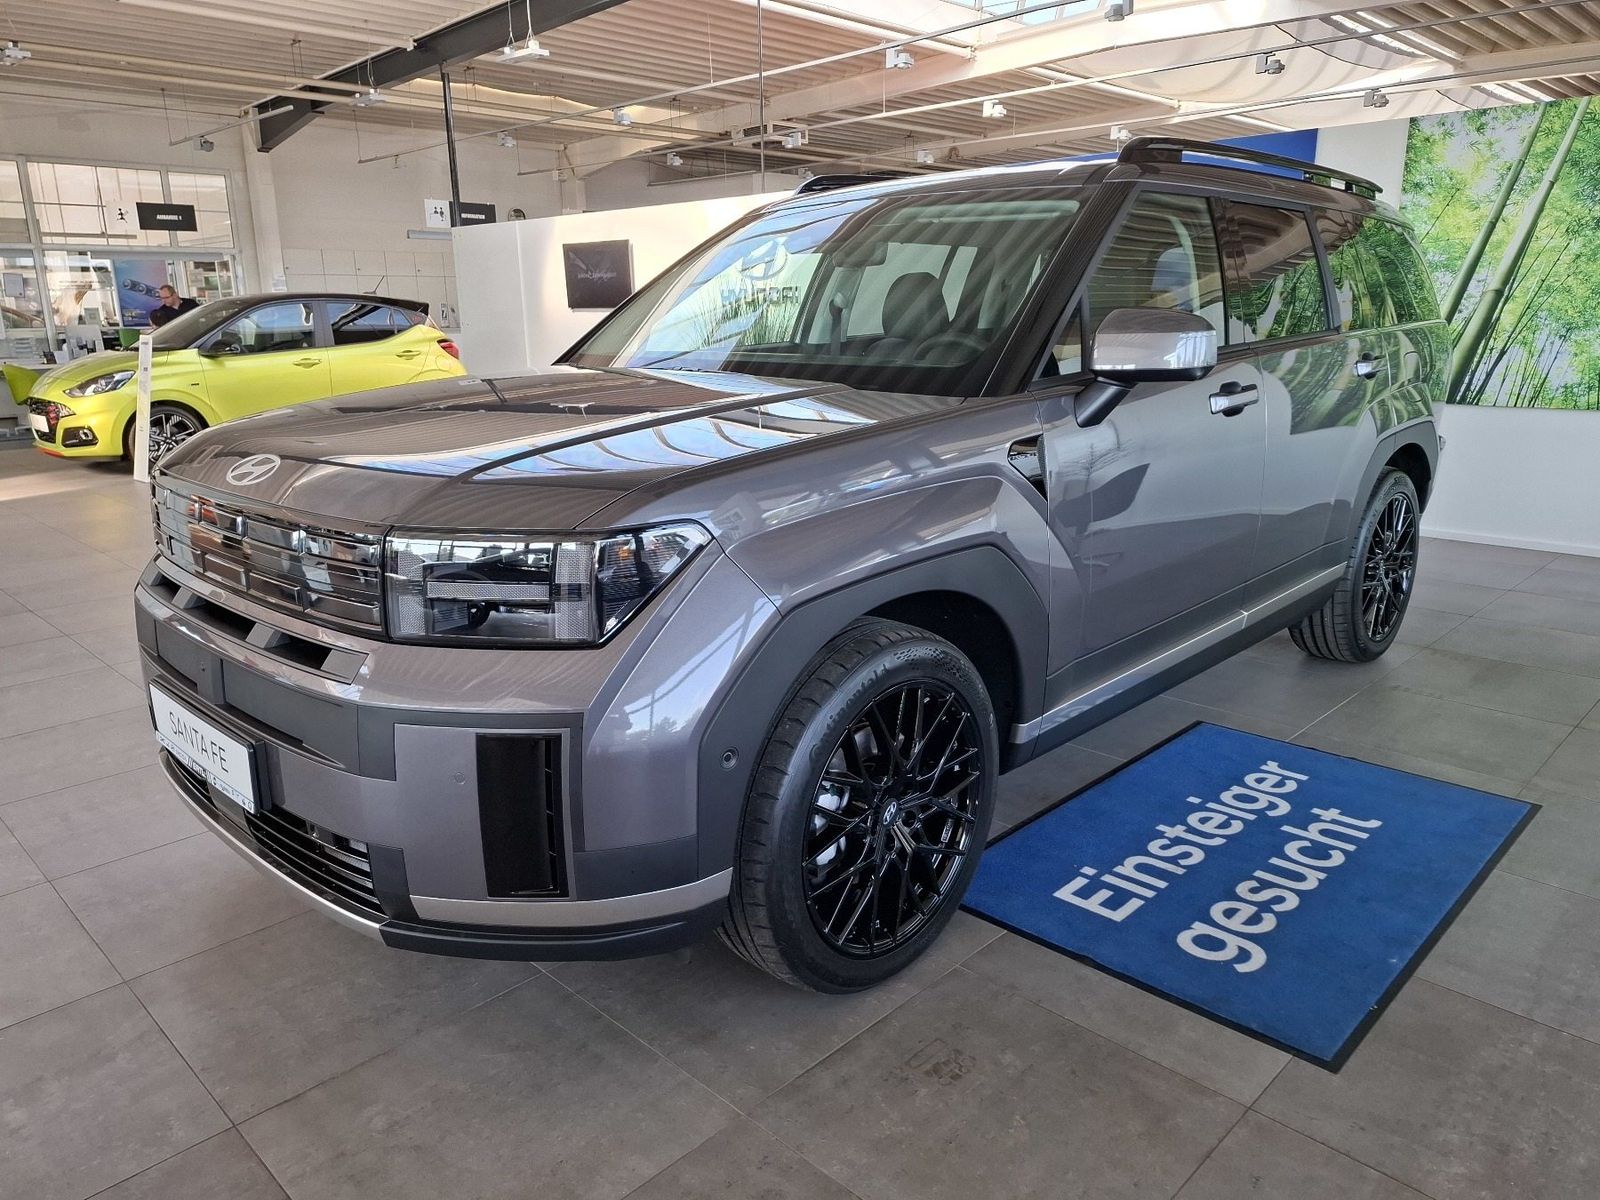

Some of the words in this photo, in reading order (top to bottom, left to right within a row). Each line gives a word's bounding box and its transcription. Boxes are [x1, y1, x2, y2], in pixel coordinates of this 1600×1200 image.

[170, 712, 209, 757] SANTA
[211, 742, 229, 773] FE
[1052, 760, 1309, 922] Einsteiger
[1176, 807, 1383, 973] gesucht
